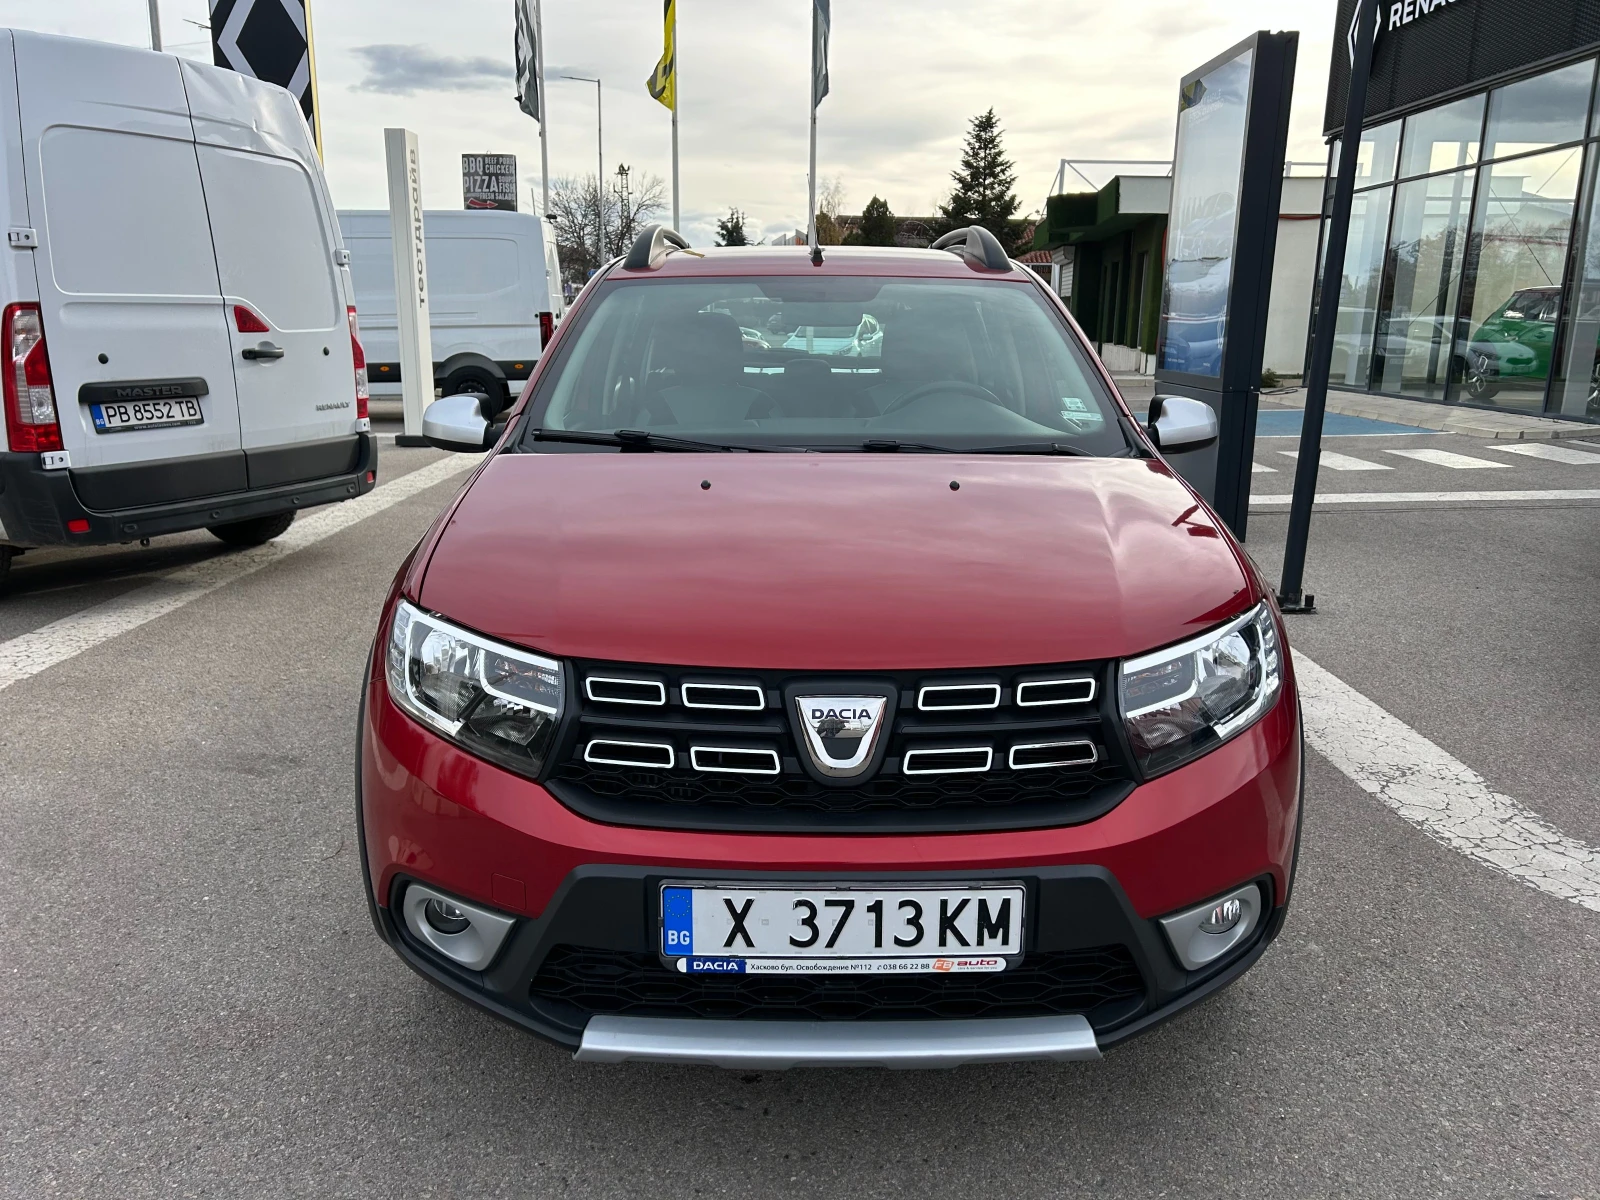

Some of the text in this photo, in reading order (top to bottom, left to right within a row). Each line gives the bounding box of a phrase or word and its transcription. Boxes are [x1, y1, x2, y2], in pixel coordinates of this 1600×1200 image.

[1389, 0, 1456, 31] REN
[462, 157, 483, 175] BBQ
[485, 156, 497, 164] BEEF
[485, 164, 515, 174] CHICKEN
[463, 175, 499, 192] PIZZA
[499, 182, 516, 193] FISH
[480, 192, 495, 200] FRESH
[116, 385, 183, 397] MASTER
[105, 400, 198, 425] PB 8552 TB
[811, 708, 872, 720] DACIA
[722, 897, 1012, 949] X 3713 KM
[667, 930, 690, 945] BG
[693, 961, 739, 971] DACIA
[750, 963, 780, 971] Хасково
[780, 963, 795, 972] бул.
[796, 962, 850, 972] Освобождение
[957, 959, 998, 967] auto
